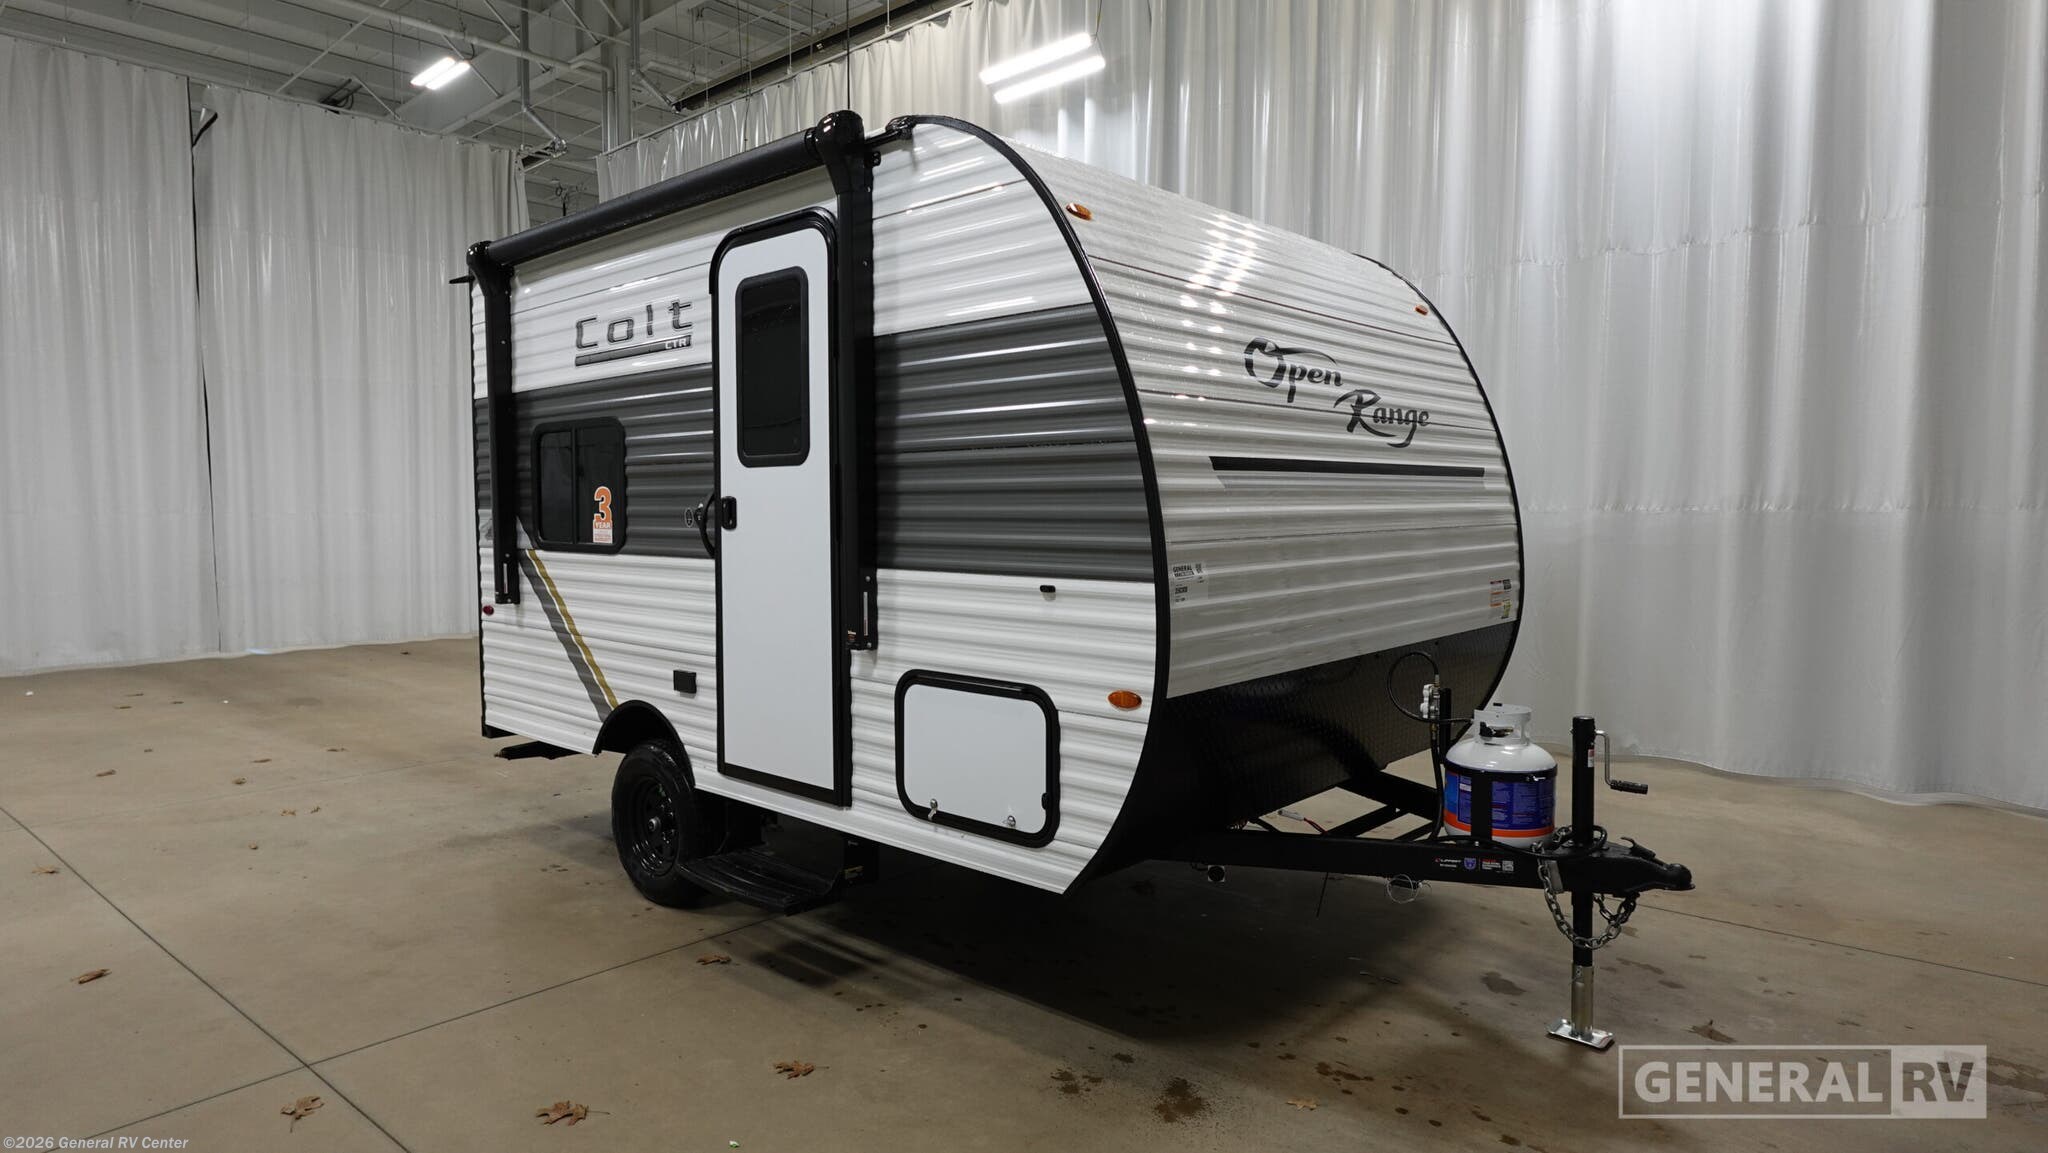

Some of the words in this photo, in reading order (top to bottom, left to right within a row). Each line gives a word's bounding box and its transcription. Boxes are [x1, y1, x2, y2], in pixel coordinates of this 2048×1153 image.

[576, 301, 692, 349] Colt
[665, 338, 687, 350] CTR
[1244, 337, 1344, 403] Open
[1333, 389, 1430, 448] Range
[594, 486, 612, 522] 3
